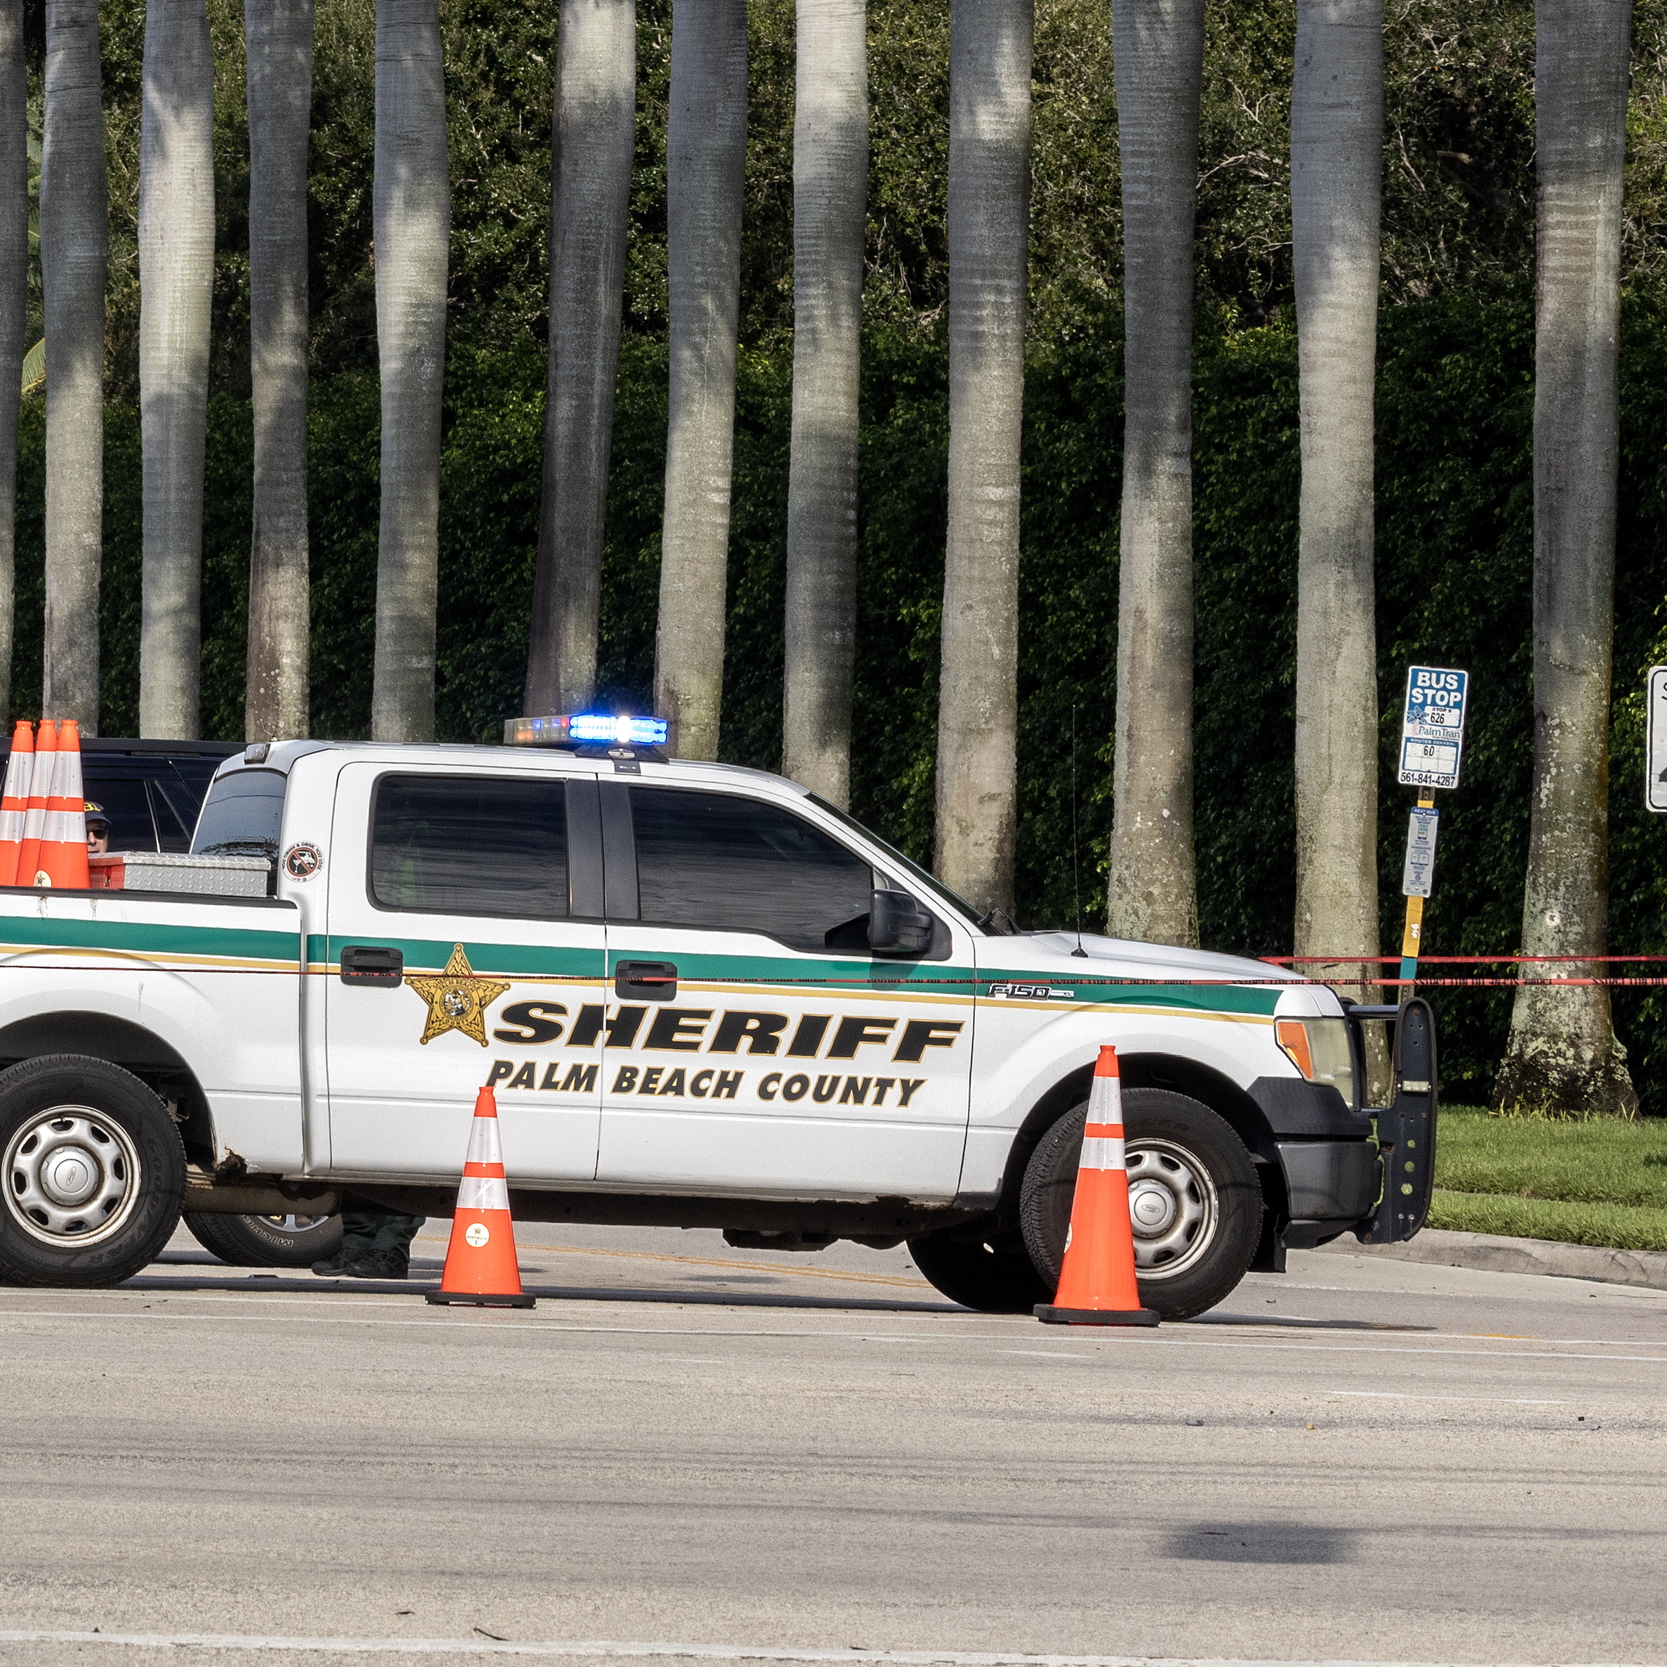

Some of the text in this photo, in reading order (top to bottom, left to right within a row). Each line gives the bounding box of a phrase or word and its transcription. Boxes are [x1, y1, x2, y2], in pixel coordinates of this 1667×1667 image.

[1417, 671, 1459, 690] BUS
[1411, 687, 1462, 707] STOP
[1430, 712, 1445, 724] 626
[1423, 745, 1435, 757] 60
[1401, 772, 1456, 788] 561-841-4287
[493, 1000, 966, 1063] SHERIFF
[485, 1059, 928, 1108] PALM BEACH COUNTY
